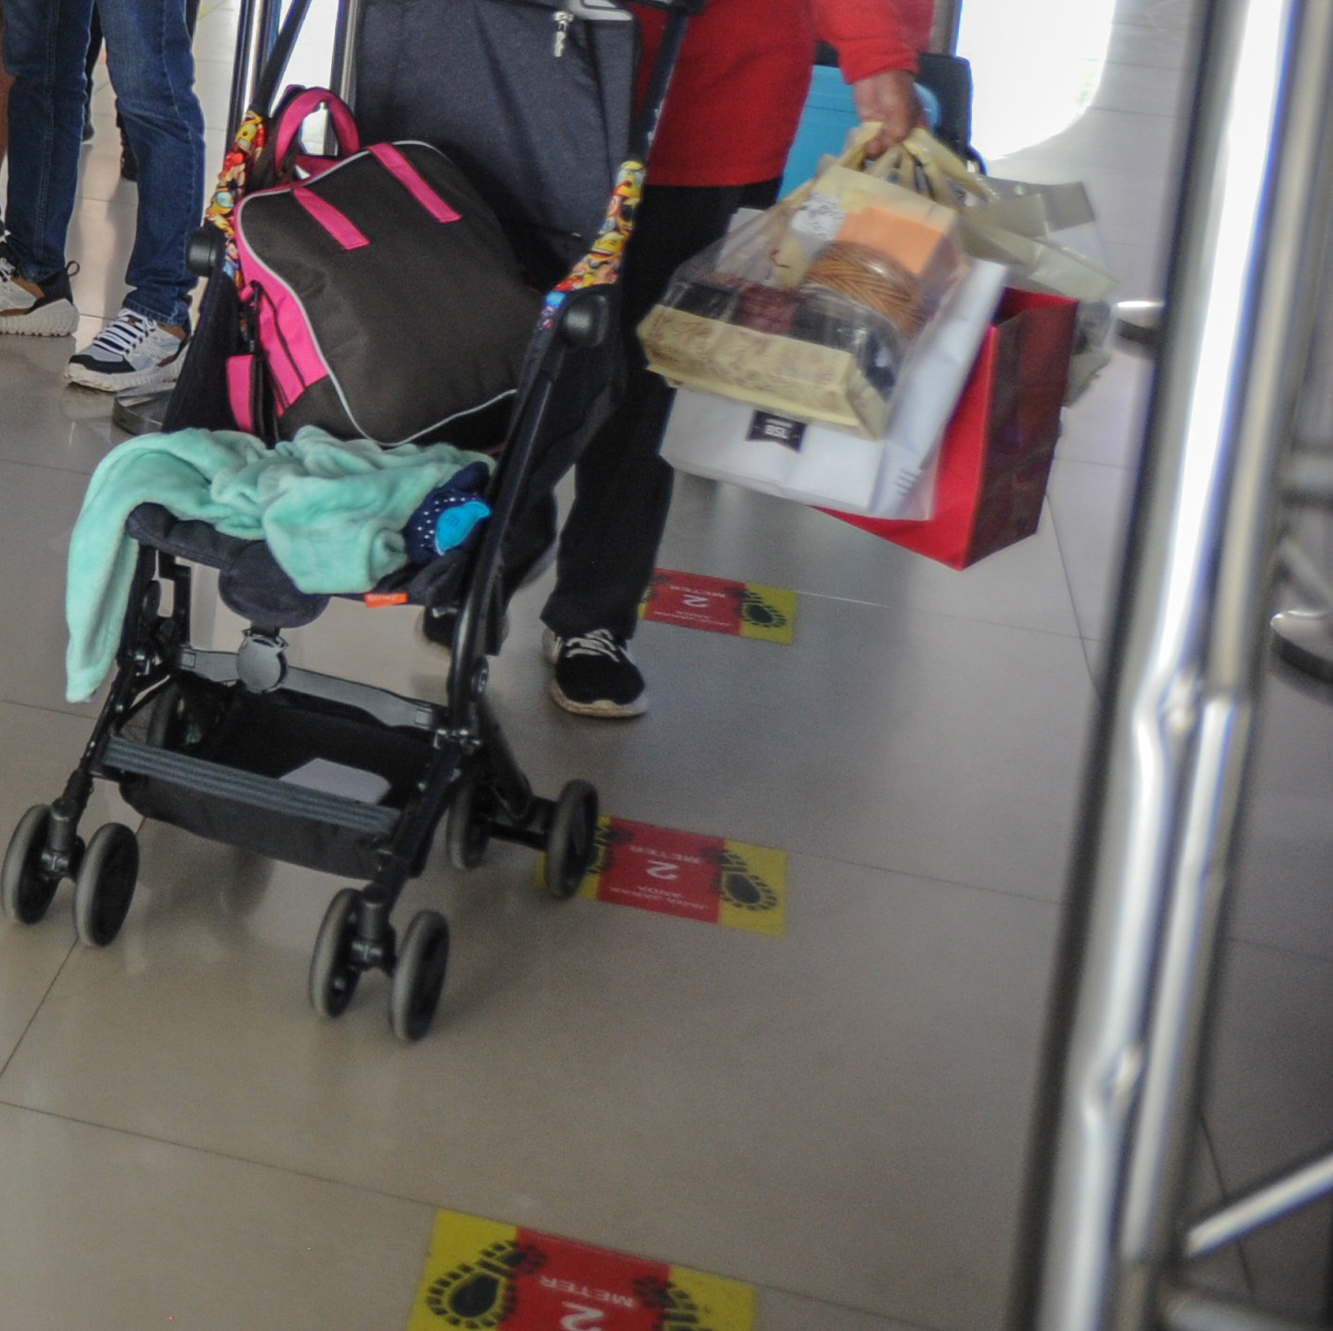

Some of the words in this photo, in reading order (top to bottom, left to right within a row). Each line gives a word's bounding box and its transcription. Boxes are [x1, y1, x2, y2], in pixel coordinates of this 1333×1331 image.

[683, 594, 709, 608] 2
[629, 844, 701, 865] METER
[646, 859, 680, 881] 2
[538, 1274, 635, 1309] METER
[559, 1300, 604, 1331] 2
